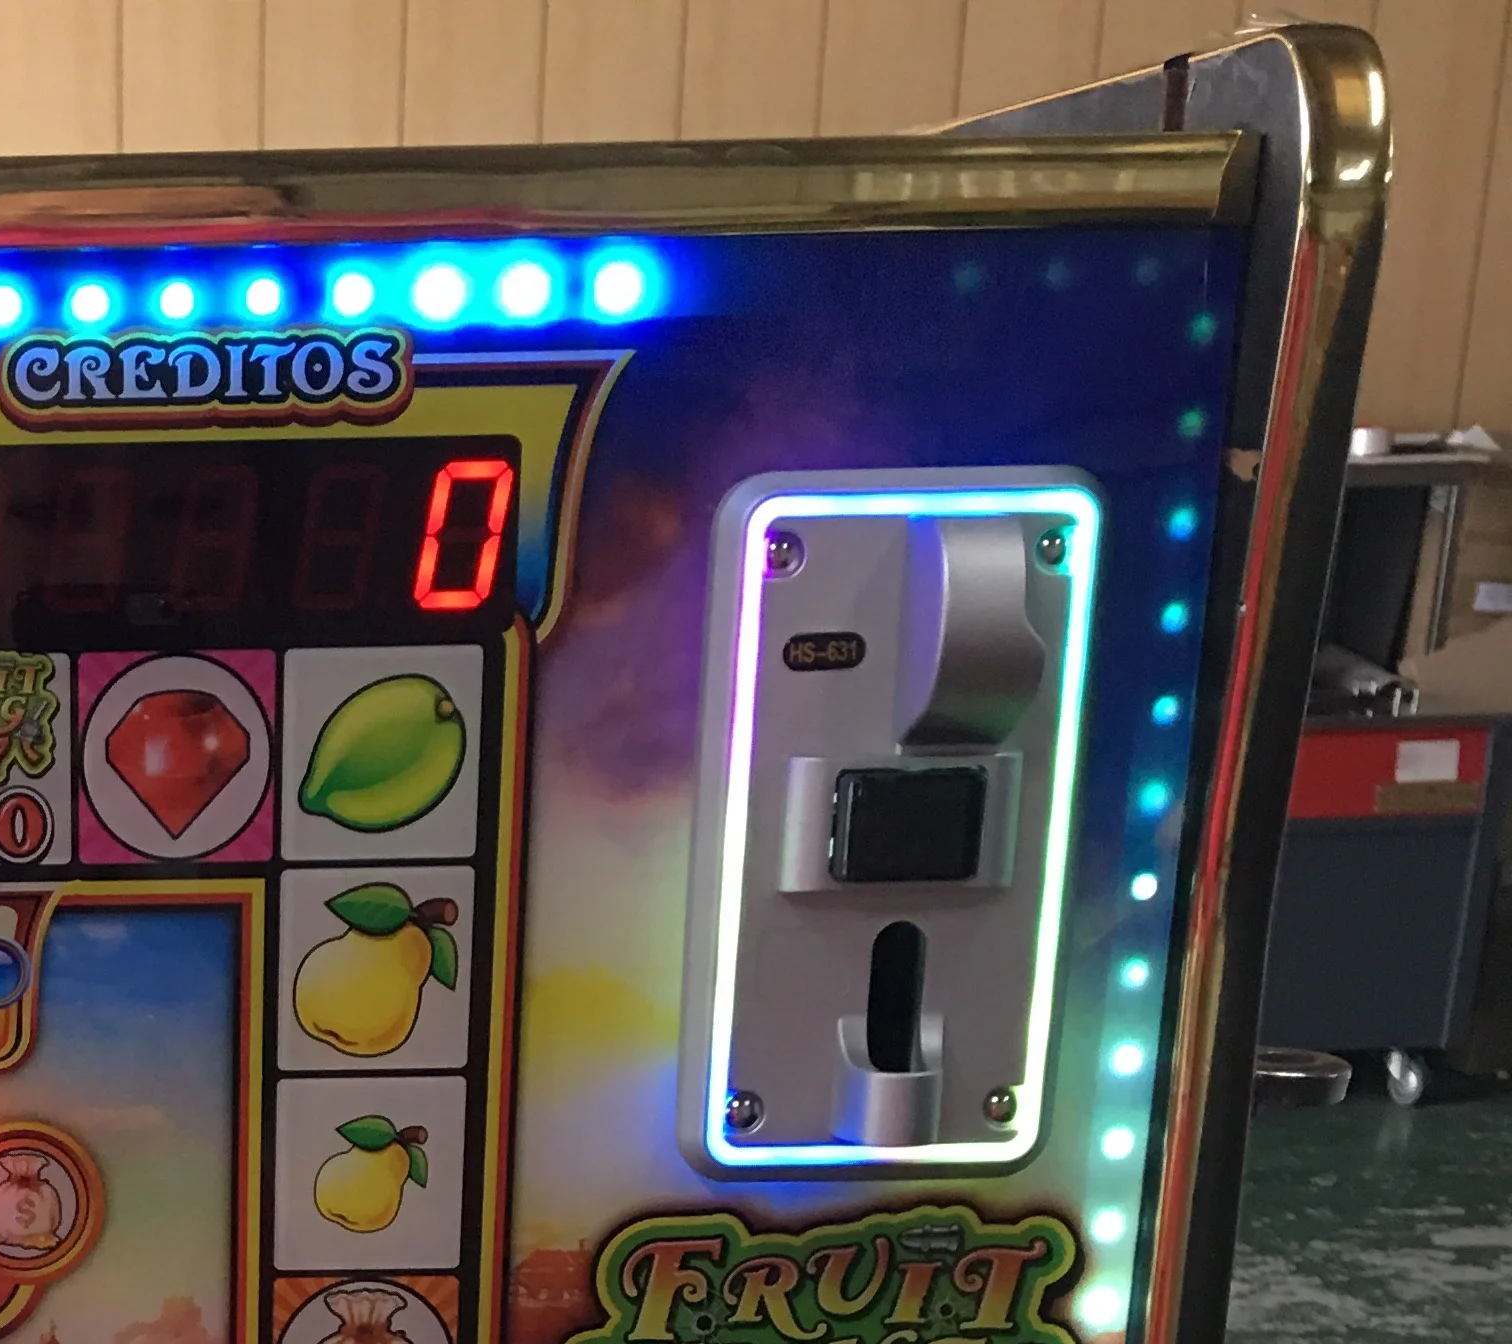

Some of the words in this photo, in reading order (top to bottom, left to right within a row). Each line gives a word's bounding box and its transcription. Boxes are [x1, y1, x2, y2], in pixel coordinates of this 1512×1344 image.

[15, 340, 396, 400] CREDITOS
[414, 459, 514, 610] 0
[790, 640, 857, 663] HS-631
[623, 1236, 1048, 1342] FRUIT
